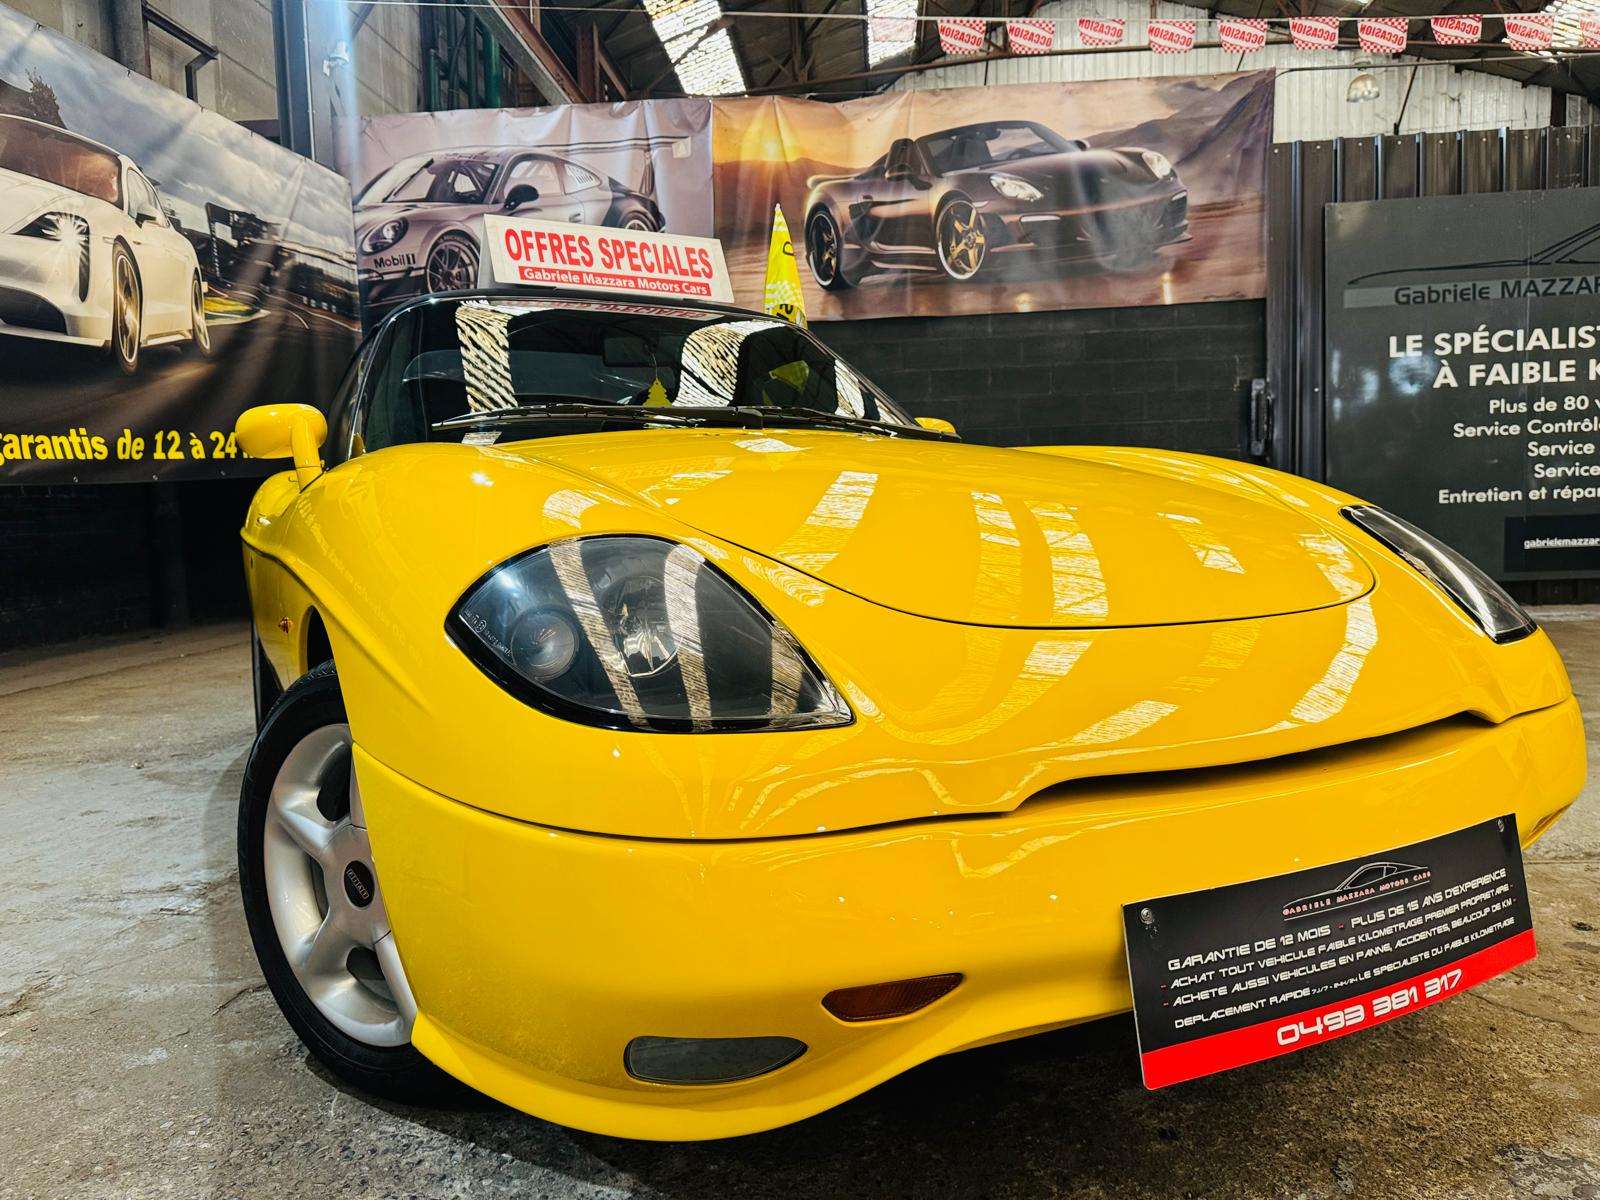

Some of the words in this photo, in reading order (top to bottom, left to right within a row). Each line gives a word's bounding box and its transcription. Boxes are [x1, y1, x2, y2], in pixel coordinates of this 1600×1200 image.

[504, 228, 594, 268] OFFRES
[598, 237, 714, 280] SPECIALES
[524, 268, 580, 284] Gabriele
[582, 274, 635, 289] Mazzara
[638, 279, 680, 293] Motors
[682, 283, 708, 295] Cars
[1394, 282, 1490, 306] Gabriele
[1389, 334, 1423, 358] LE
[1434, 324, 1600, 357] SPÉCIALIS
[1432, 359, 1459, 389] À
[1469, 359, 1577, 387] FAIBLE
[1489, 398, 1527, 414] Plus
[1533, 396, 1557, 412] de
[1563, 395, 1590, 411] 80
[1453, 421, 1521, 438] Service
[1527, 415, 1600, 434] Contrôl
[0, 427, 109, 467] arantis
[117, 429, 146, 460] de
[153, 430, 185, 460] 12
[189, 432, 206, 459] à
[209, 430, 238, 459] 24
[1527, 440, 1595, 457] Service
[1534, 461, 1600, 478] Service
[1438, 486, 1523, 504] Entretien
[1528, 486, 1547, 500] et
[1282, 897, 1331, 916] GABRIELE
[1336, 887, 1376, 903] MAZZARA
[1380, 877, 1409, 892] MOTORS
[1413, 870, 1432, 881] CARS
[1168, 943, 1251, 972] GARANTIE
[1255, 937, 1277, 953] DE
[1280, 933, 1294, 946] 12
[1297, 924, 1331, 942] MOIS
[1350, 910, 1386, 929] PLUS
[1388, 904, 1405, 918] DE
[1407, 899, 1420, 912] 15
[1422, 893, 1443, 909] ANS
[1170, 970, 1216, 989] ACHAT
[1218, 961, 1255, 978] TOUT
[1257, 947, 1316, 968] VEHICULE
[1318, 935, 1356, 954] FAIBLE
[1358, 916, 1424, 944] KILOMETRAGE
[1424, 903, 1460, 923] PREMIER
[1460, 883, 1510, 909] PROPRIETAIRE
[1172, 985, 1229, 1007] ACHETE
[1231, 975, 1270, 994] AUSSI
[1271, 958, 1337, 982] VEHICULES
[1339, 952, 1355, 966] EN
[1356, 942, 1393, 961] PANNE,
[1451, 906, 1491, 929] BEAUCOUP
[1491, 902, 1502, 913] DE
[1502, 897, 1513, 909] KM
[1174, 998, 1267, 1029] DEPLACEMENT
[1269, 987, 1312, 1006] RAPIDE
[1358, 969, 1372, 981] LE
[1372, 950, 1430, 977] SPECIALISTE
[1431, 945, 1443, 957] DU
[1444, 935, 1470, 952] FAIBLE
[1470, 916, 1515, 941] KILOMETRAGE
[1276, 1004, 1366, 1046] 0493
[1372, 985, 1419, 1018] 381
[1424, 968, 1462, 999] 317
